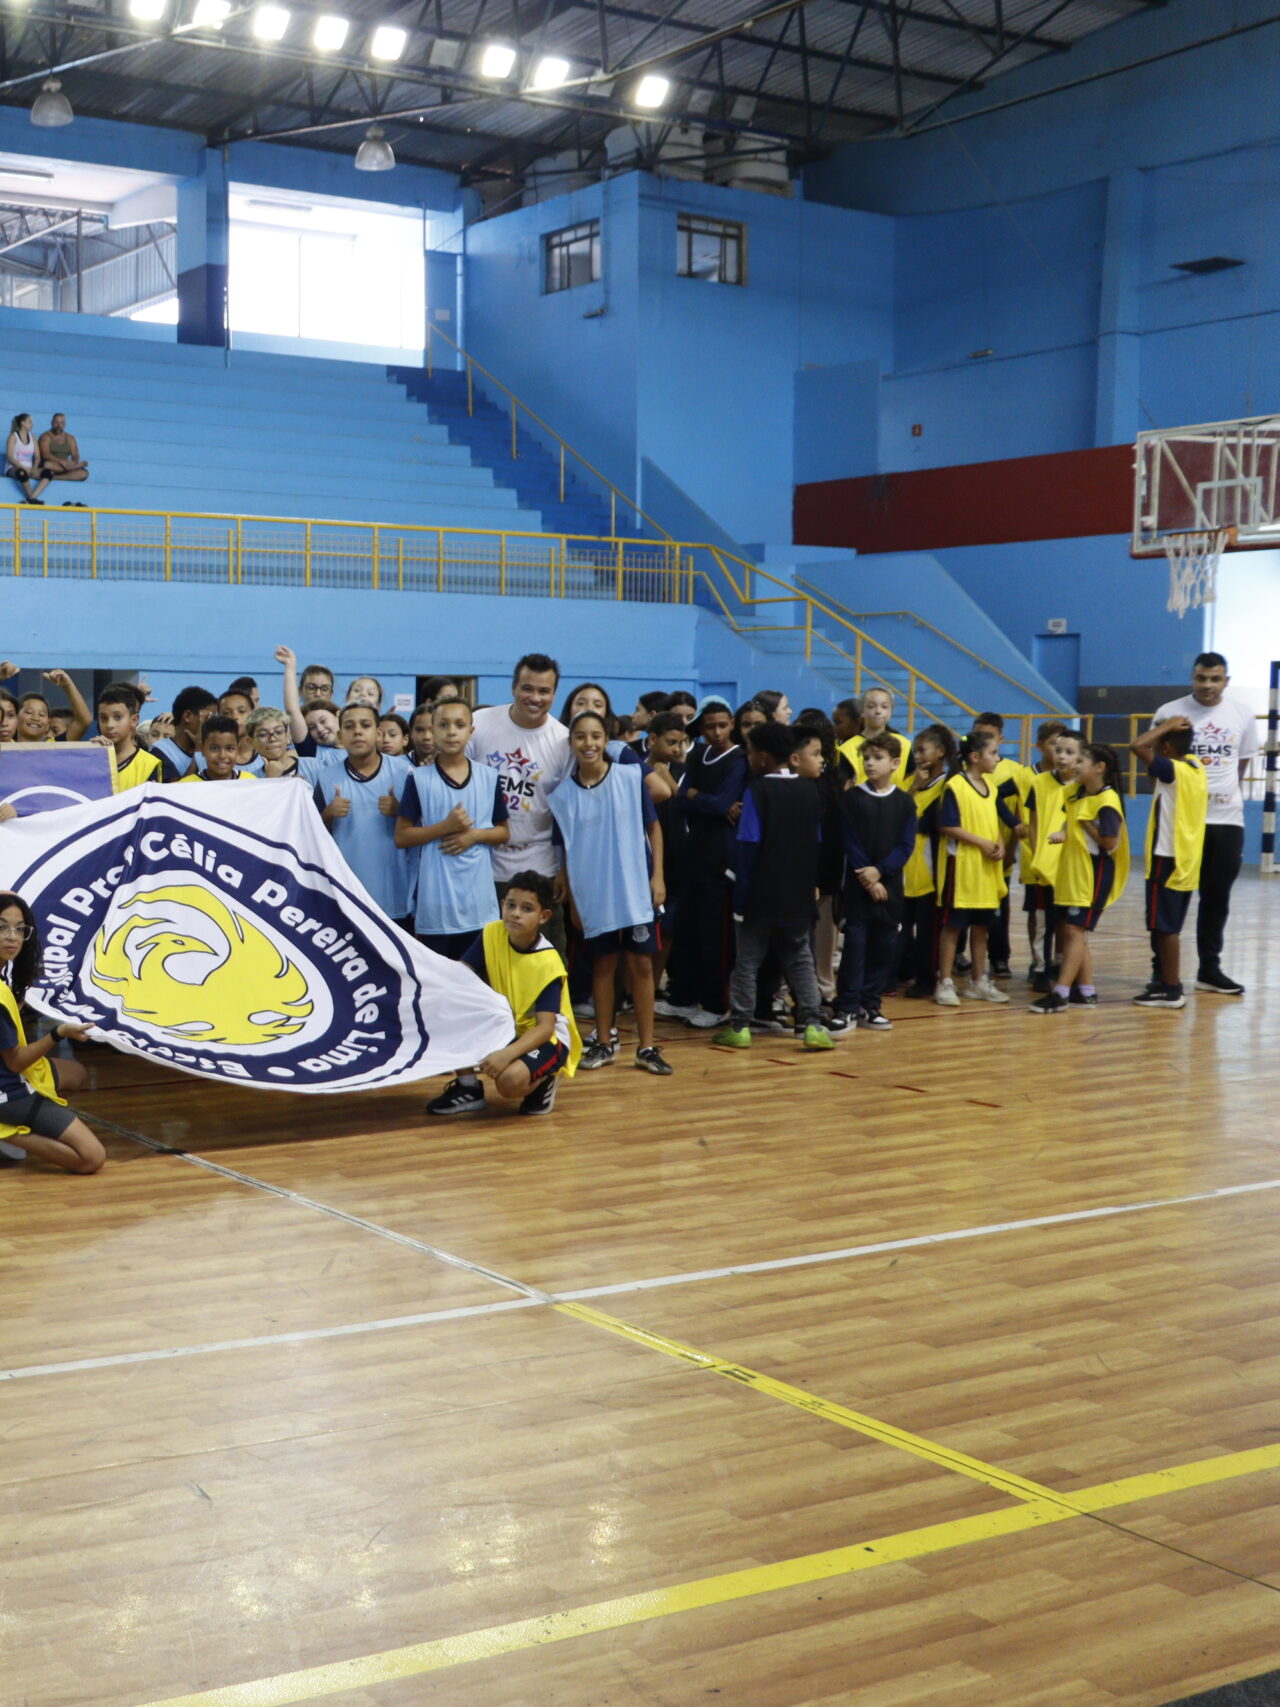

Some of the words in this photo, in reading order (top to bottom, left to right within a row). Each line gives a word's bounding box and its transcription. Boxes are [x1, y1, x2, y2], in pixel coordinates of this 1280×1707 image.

[498, 774, 535, 797] EMS
[251, 879, 370, 982] Pereira
[352, 983, 387, 1024] de
[298, 1029, 385, 1072] Lima
